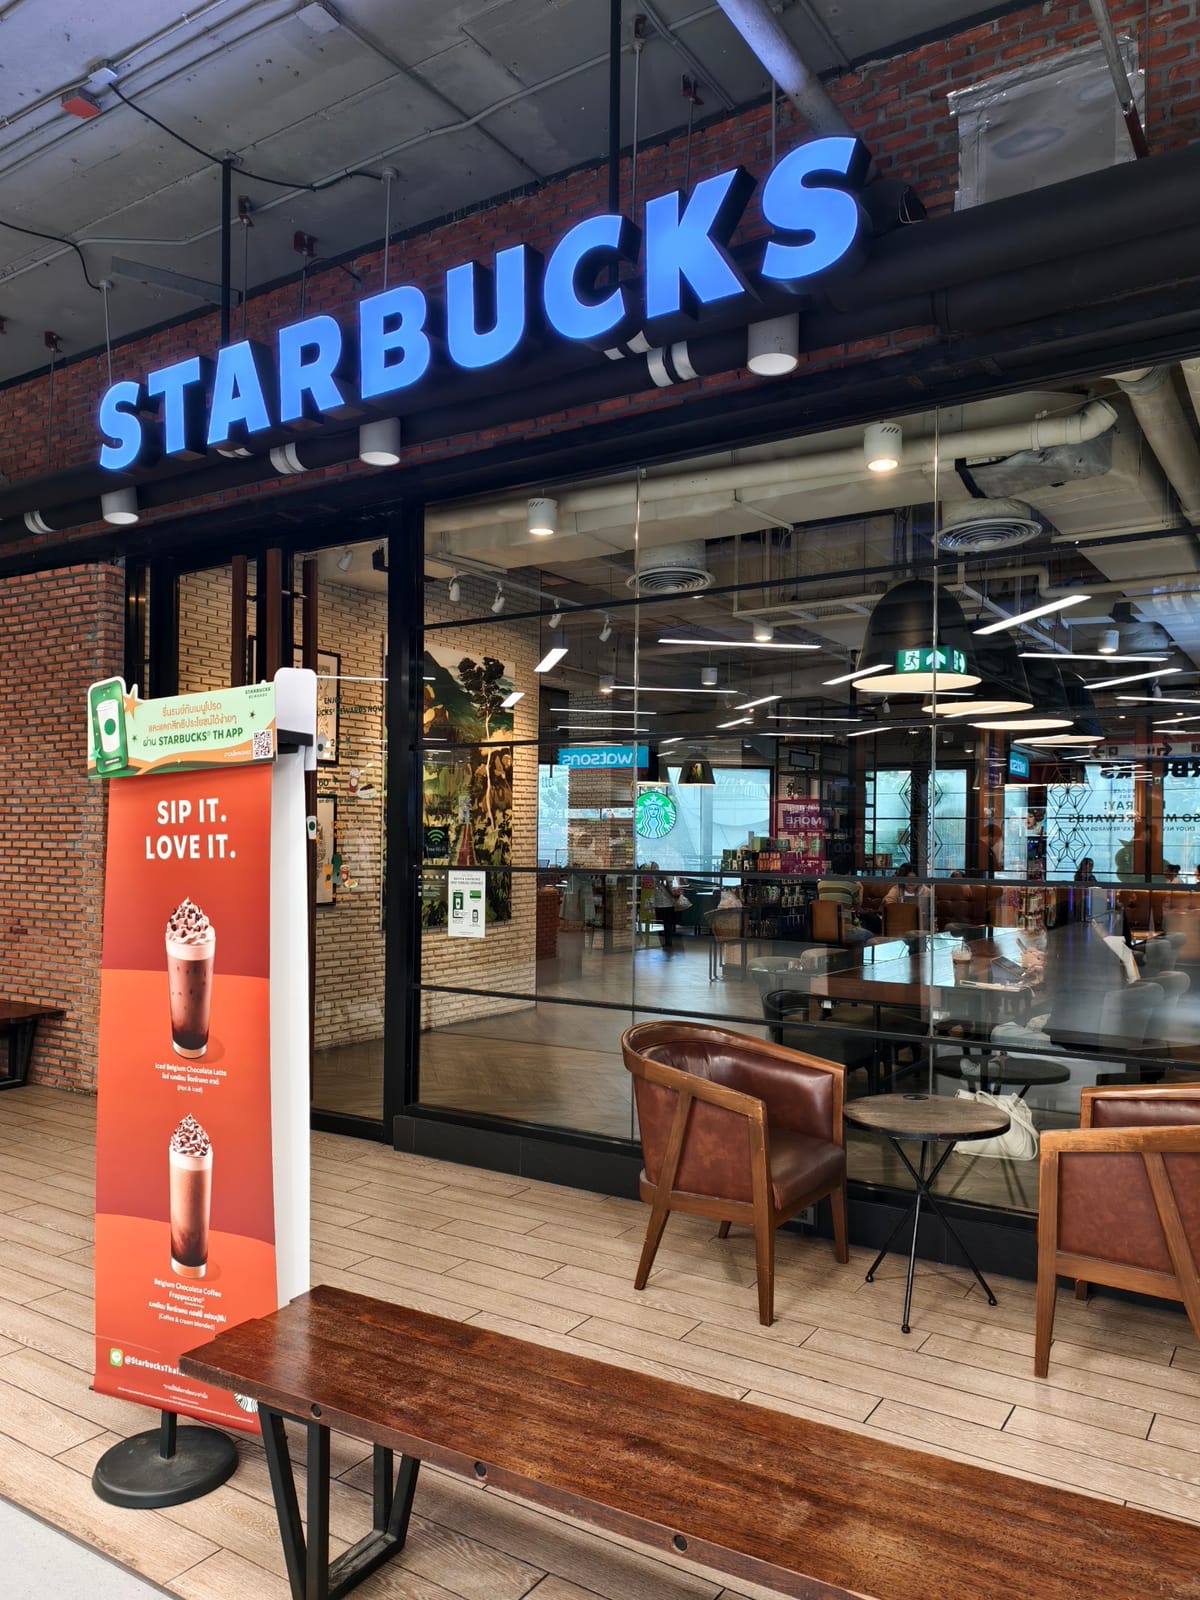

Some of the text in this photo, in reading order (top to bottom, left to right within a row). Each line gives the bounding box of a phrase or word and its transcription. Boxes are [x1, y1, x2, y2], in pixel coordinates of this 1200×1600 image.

[98, 136, 859, 471] STARBUCKS
[142, 736, 157, 747] ผ่าน
[212, 730, 225, 740] TH
[226, 727, 244, 739] APP
[157, 798, 227, 825] SIP IT.
[145, 834, 236, 860] LOVE IT.
[187, 1065, 213, 1075] Chocolate
[175, 1282, 202, 1294] Chocolate
[203, 1287, 222, 1298] Coffee
[125, 1356, 187, 1377] @StarbucksThai
